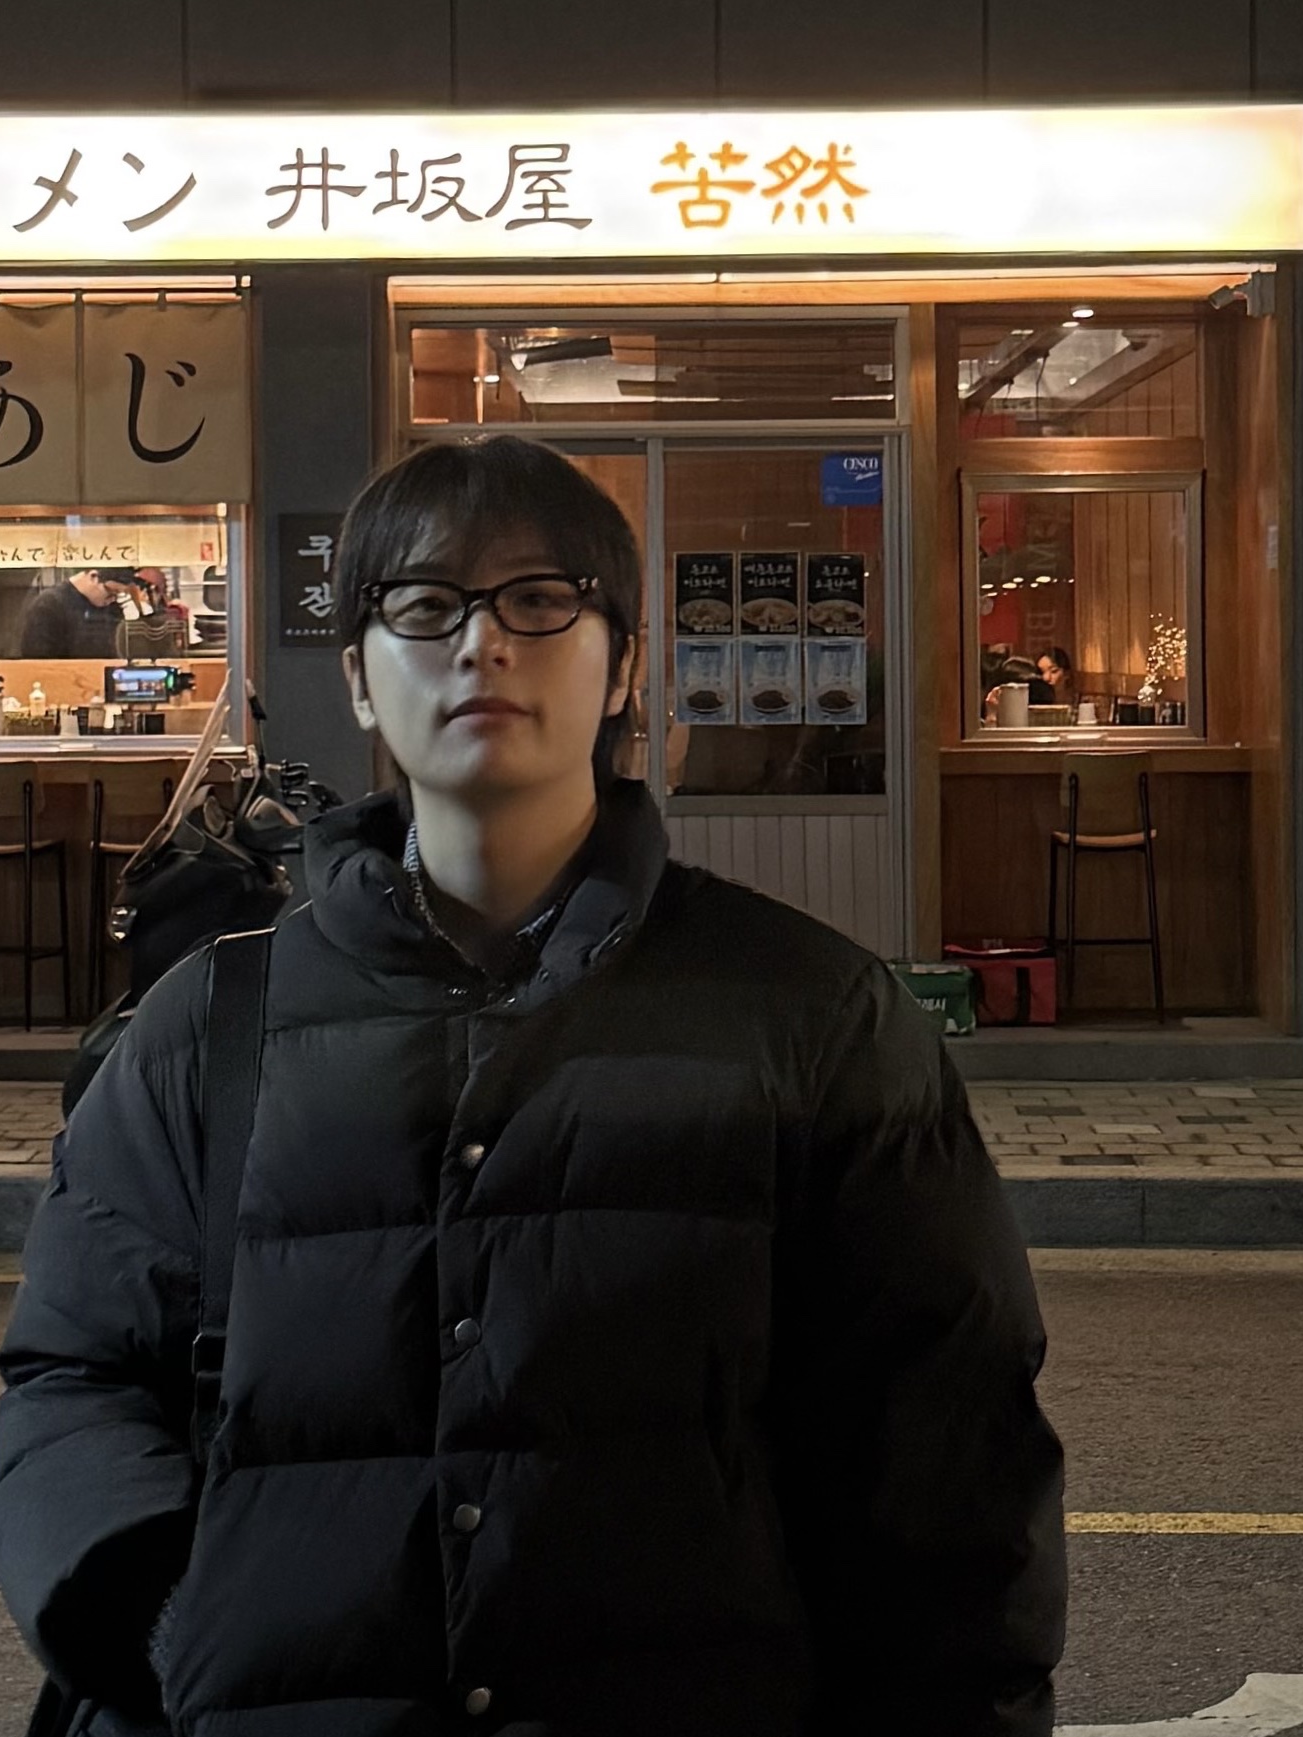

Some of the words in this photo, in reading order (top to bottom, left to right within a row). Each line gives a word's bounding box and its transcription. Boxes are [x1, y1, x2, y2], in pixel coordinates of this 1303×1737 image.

[265, 142, 592, 233] 井坂屋
[652, 141, 872, 230] 苦然
